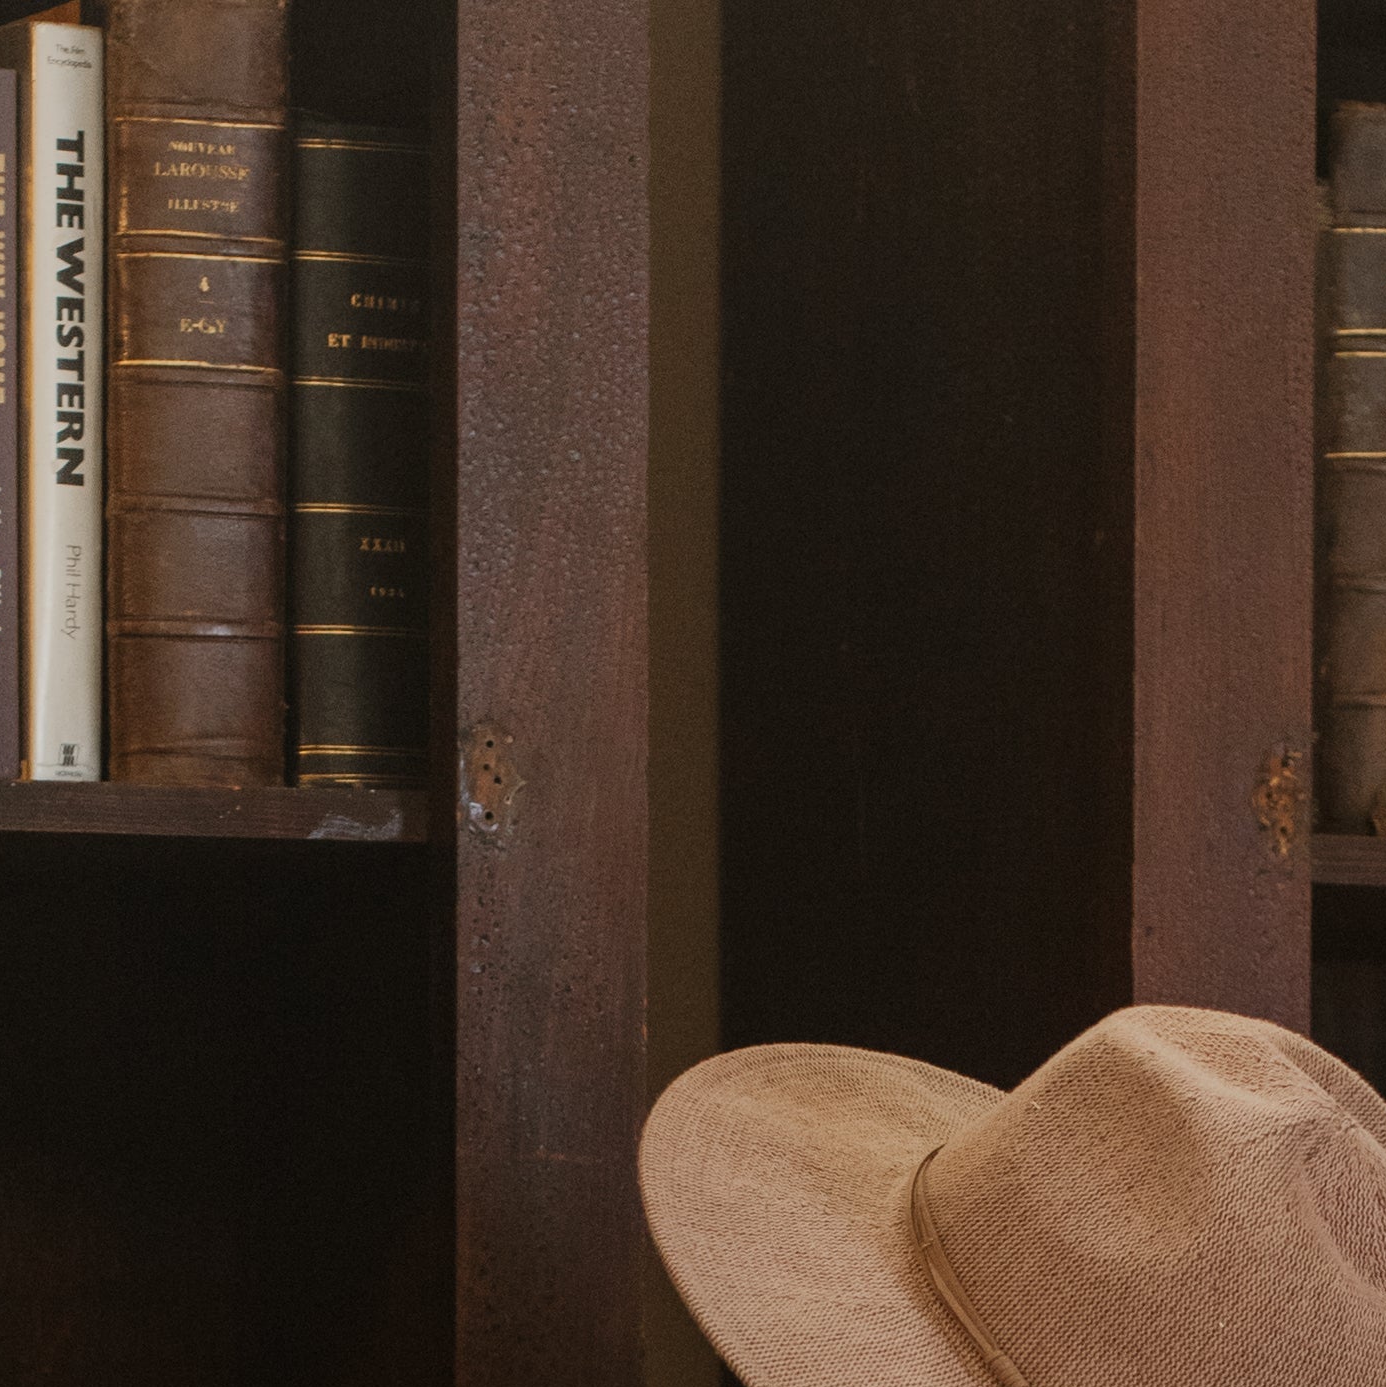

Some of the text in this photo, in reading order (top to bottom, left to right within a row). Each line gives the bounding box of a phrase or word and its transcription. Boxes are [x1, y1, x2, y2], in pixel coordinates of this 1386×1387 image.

[153, 162, 251, 181] LAROUSSE
[56, 130, 85, 487] THE WESTERN
[327, 333, 352, 348] ET
[60, 544, 83, 641] Phil Hardy
